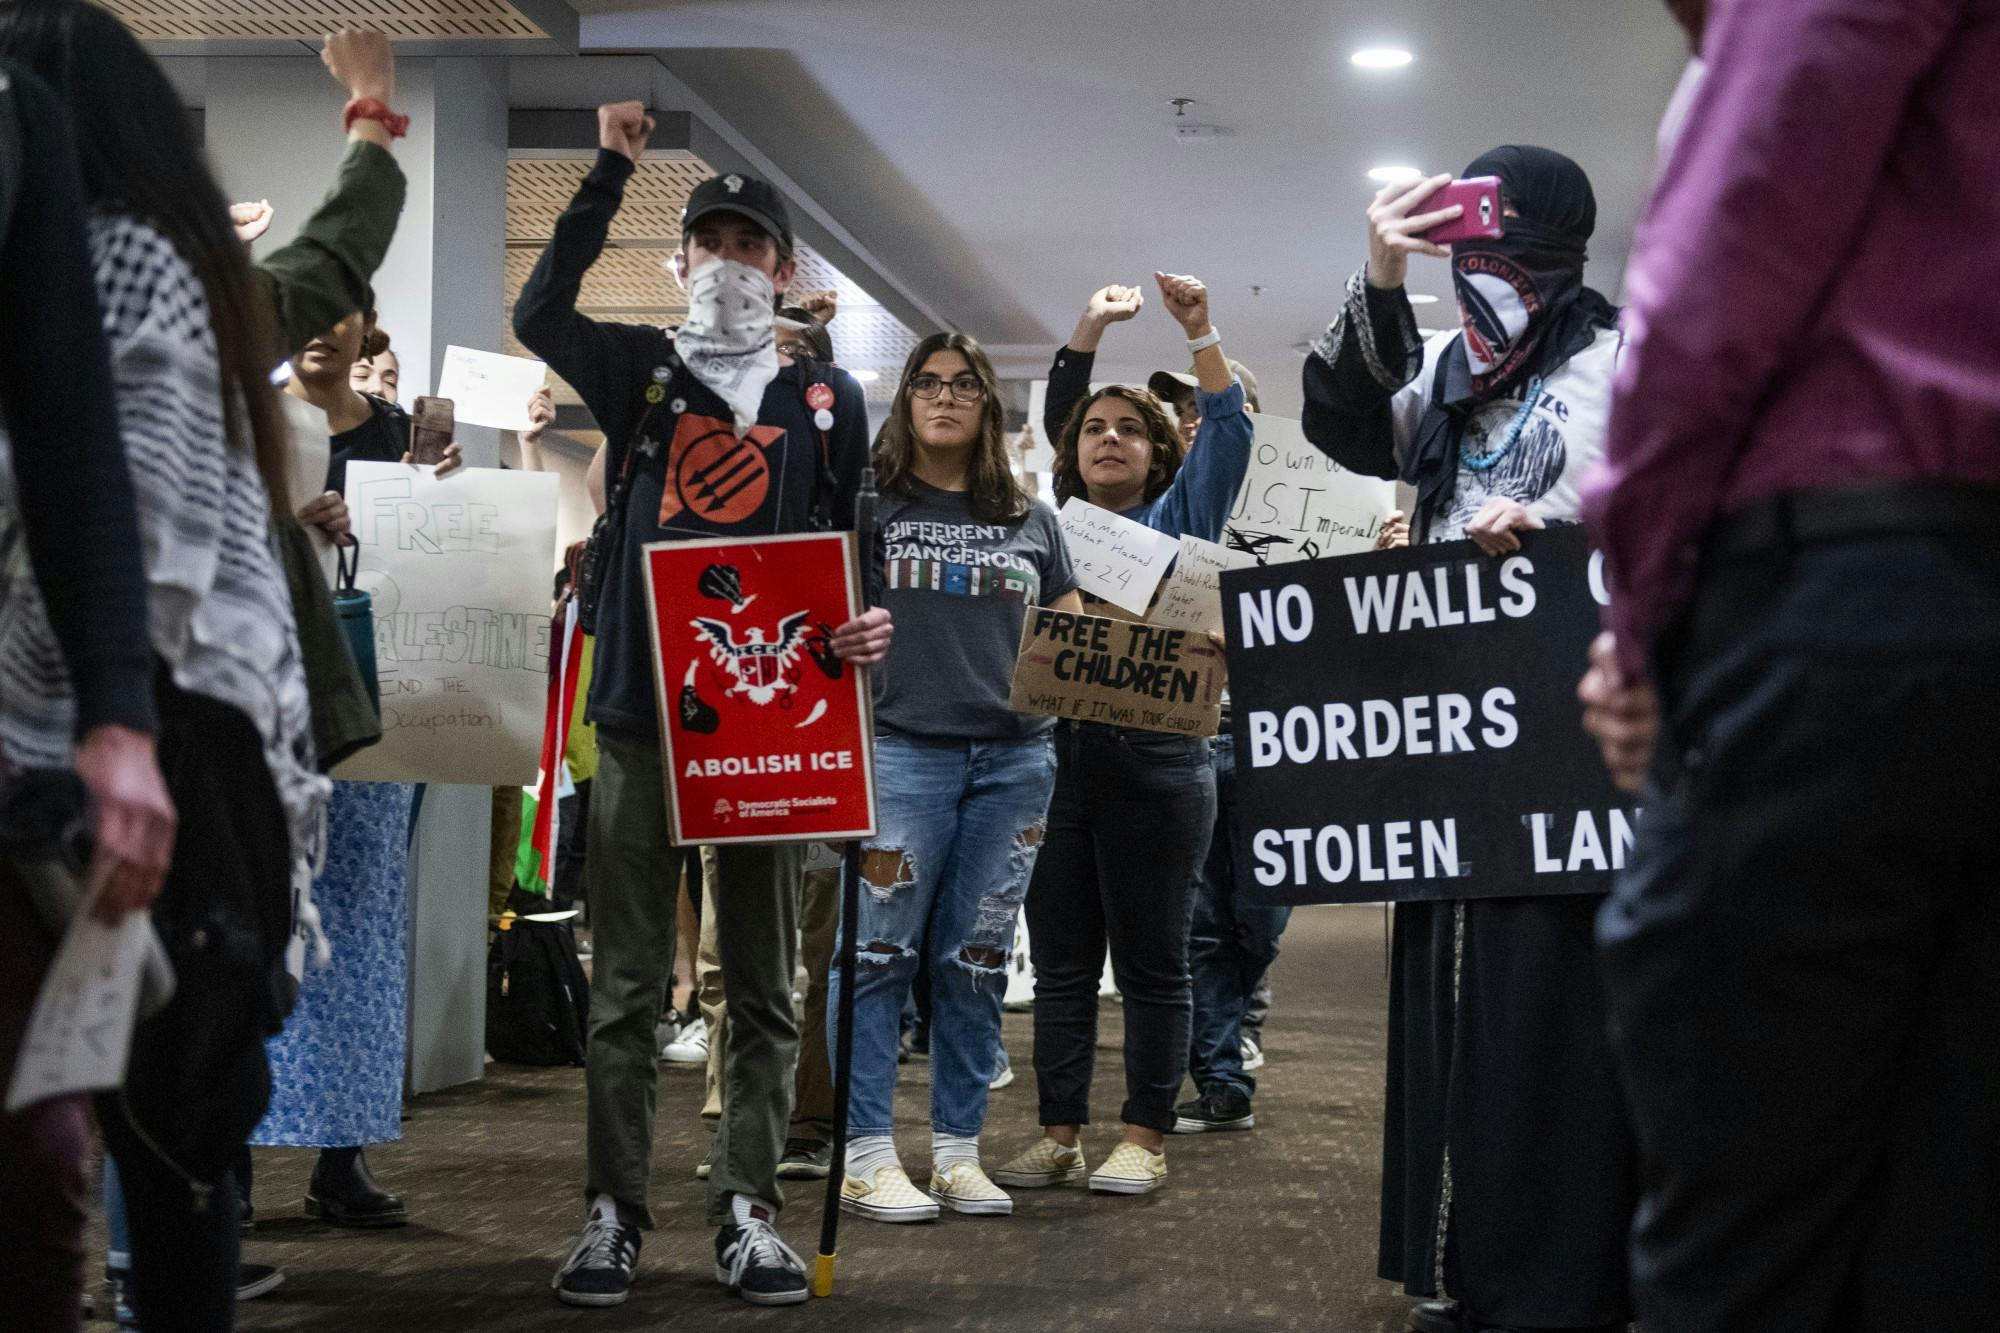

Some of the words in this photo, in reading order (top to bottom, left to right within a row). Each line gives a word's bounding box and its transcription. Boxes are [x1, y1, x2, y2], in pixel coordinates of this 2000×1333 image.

[358, 477, 500, 556] FREE
[884, 521, 1007, 540] DIFFERENT
[884, 543, 1036, 575] DANGEROUS
[1097, 563, 1133, 591] 24
[1238, 583, 1314, 649] NO
[1343, 556, 1537, 635] WALLS
[1033, 610, 1114, 652] FREE
[1128, 624, 1186, 662] THE
[434, 675, 473, 694] THE
[1027, 693, 1066, 712] WHAT
[1072, 698, 1083, 716] IF
[1090, 702, 1108, 717] IT
[1109, 705, 1135, 724] WAS
[1141, 710, 1165, 726] YOUR
[1248, 686, 1520, 769] BORDERS
[684, 754, 802, 778] ABOLISH
[811, 750, 853, 771] ICE
[737, 798, 791, 811] Democratic
[791, 796, 838, 808] Socialists
[738, 809, 749, 818] of
[750, 808, 790, 818] America
[1252, 817, 1460, 888] STOLEN
[1530, 807, 1645, 874] LAN
